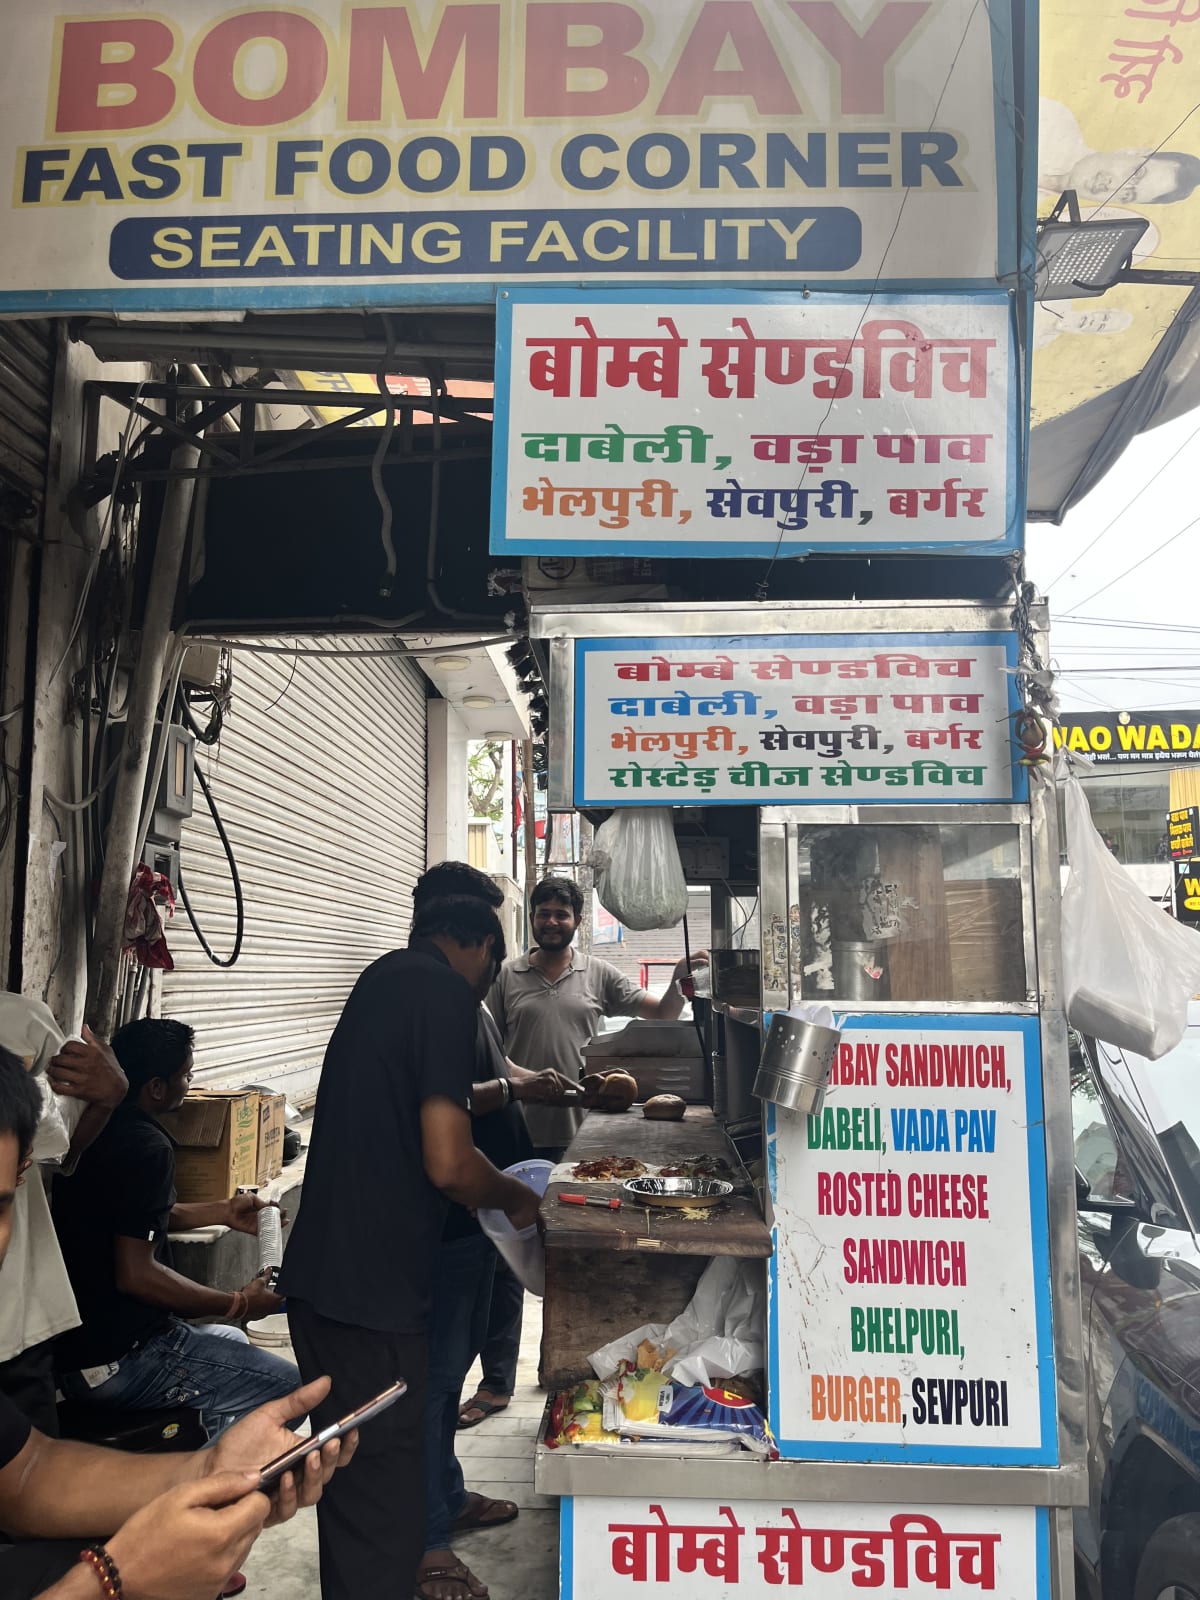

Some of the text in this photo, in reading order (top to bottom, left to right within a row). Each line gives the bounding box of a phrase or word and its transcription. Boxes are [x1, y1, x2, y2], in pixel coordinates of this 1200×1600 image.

[55, 0, 932, 133] BOMBAY
[22, 132, 962, 203] FAST FOOD CORNER
[151, 219, 814, 269] SEATING FACILITY
[526, 317, 996, 399] बोम्बे सेण्डविच
[521, 424, 992, 473] दाबेली, वड़ा पाव
[523, 477, 988, 530] भेलपुरी, सेवपुरी, बर्गर
[614, 654, 977, 681] बोम्बे सेण्डविच
[608, 691, 984, 720] दाबेली, वड़ा पाव
[611, 723, 984, 759] भेलपुरी, सेवपुरी, बर्गर
[727, 761, 813, 786] चीज
[820, 760, 988, 786] सेण्डविच
[885, 1043, 1011, 1093] SANDWICH,
[807, 1106, 996, 1155] DABELI, VADA PAV
[818, 1169, 989, 1219] ROSTED CHEESE
[843, 1238, 966, 1286] SANDWICH
[851, 1307, 964, 1361] BHELPURI,
[811, 1374, 1008, 1429] BURGER, SEVPURI
[608, 1504, 1001, 1590] बोम्बे सेण्डविच
